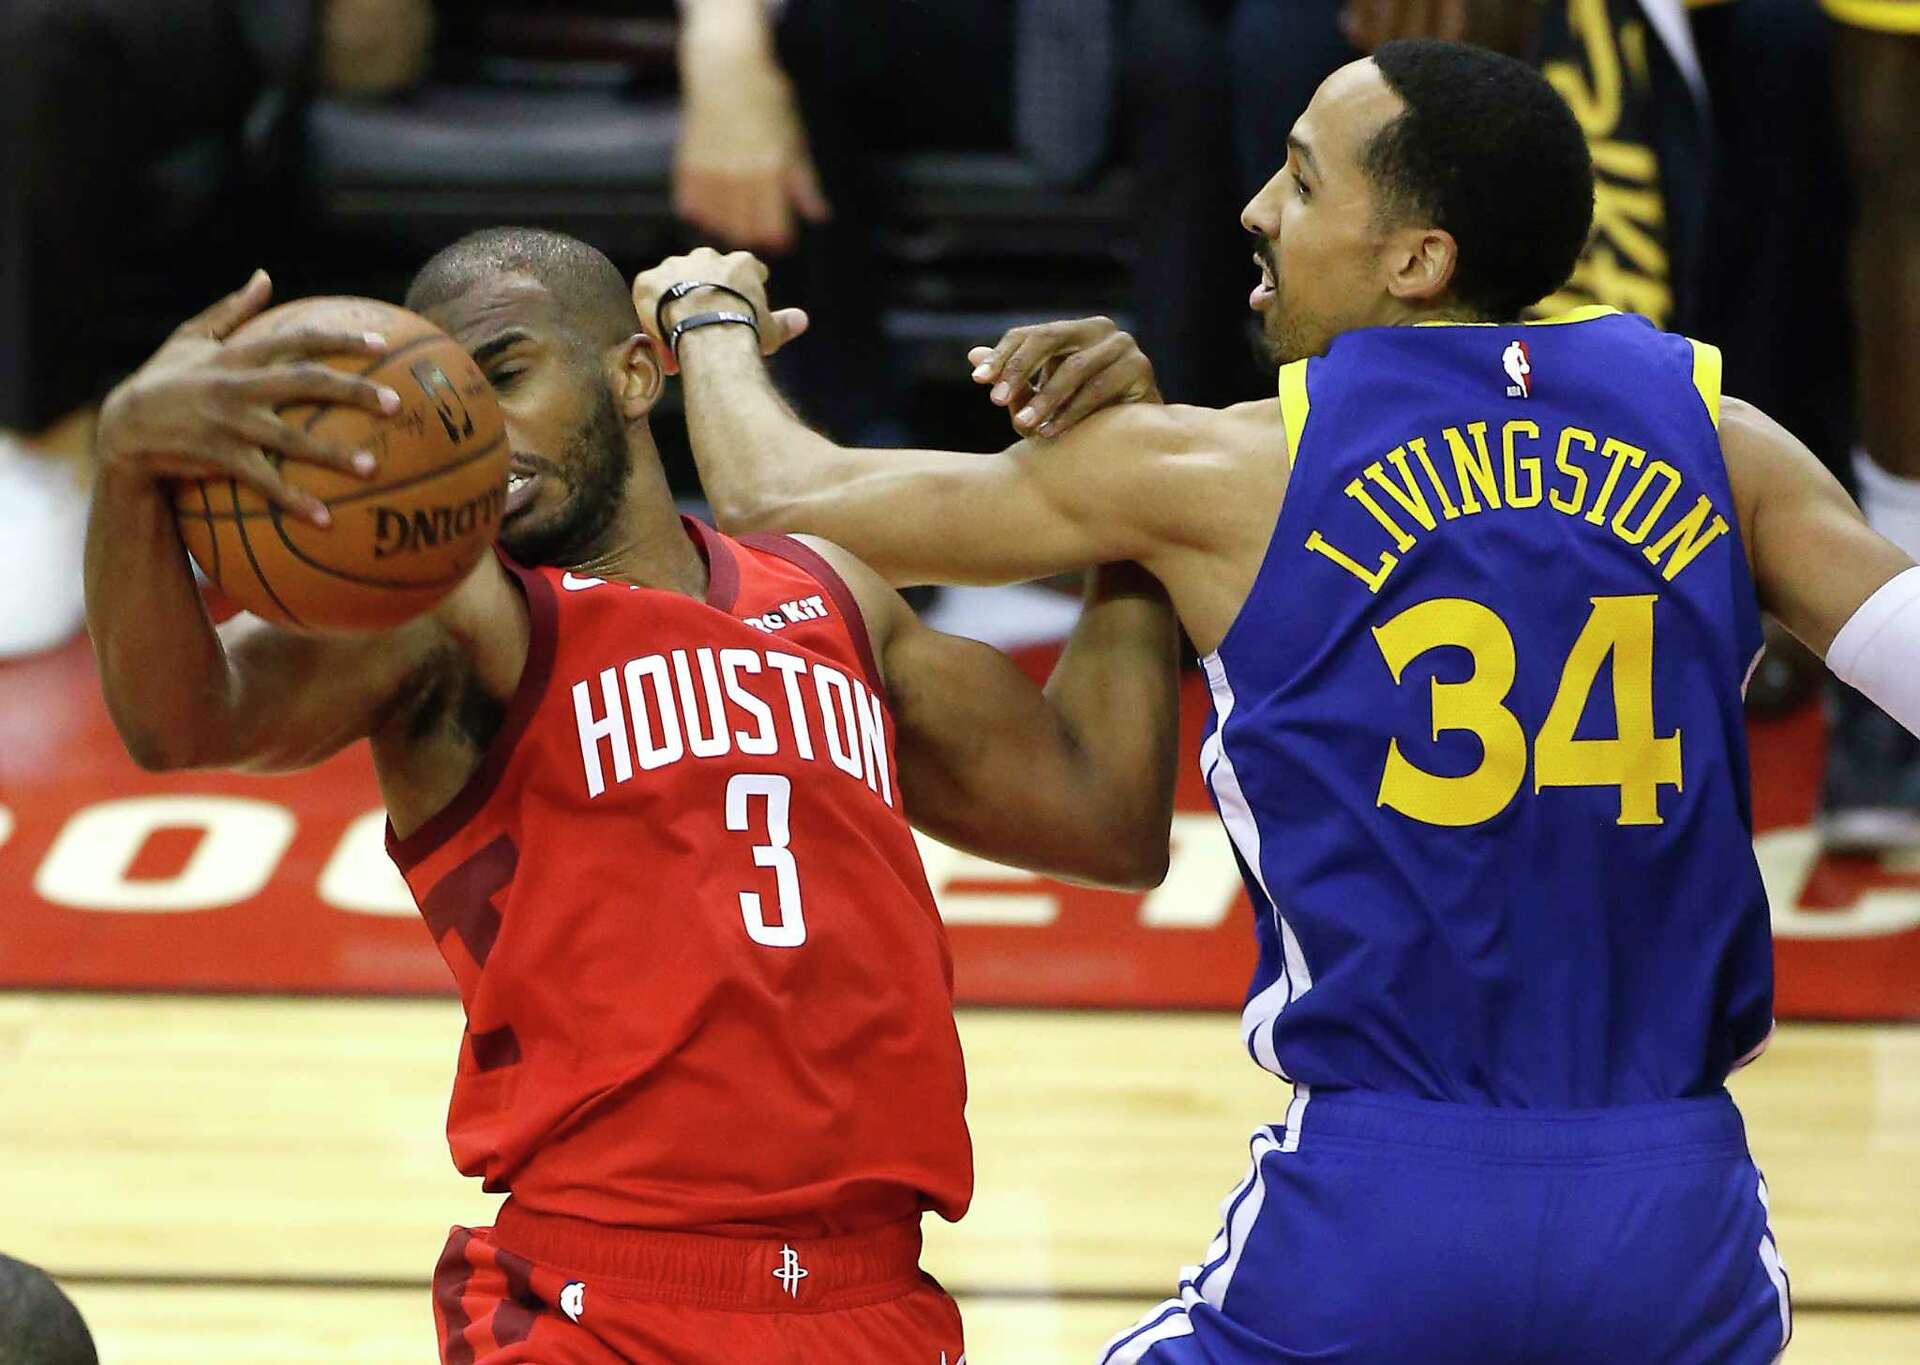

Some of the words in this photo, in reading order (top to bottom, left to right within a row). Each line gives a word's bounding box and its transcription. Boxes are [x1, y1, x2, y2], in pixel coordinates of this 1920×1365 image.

[1305, 420, 1729, 594] LIVINGSTON
[571, 647, 893, 809] HOUSTON
[1371, 594, 1683, 827] 34
[725, 773, 807, 948] 3
